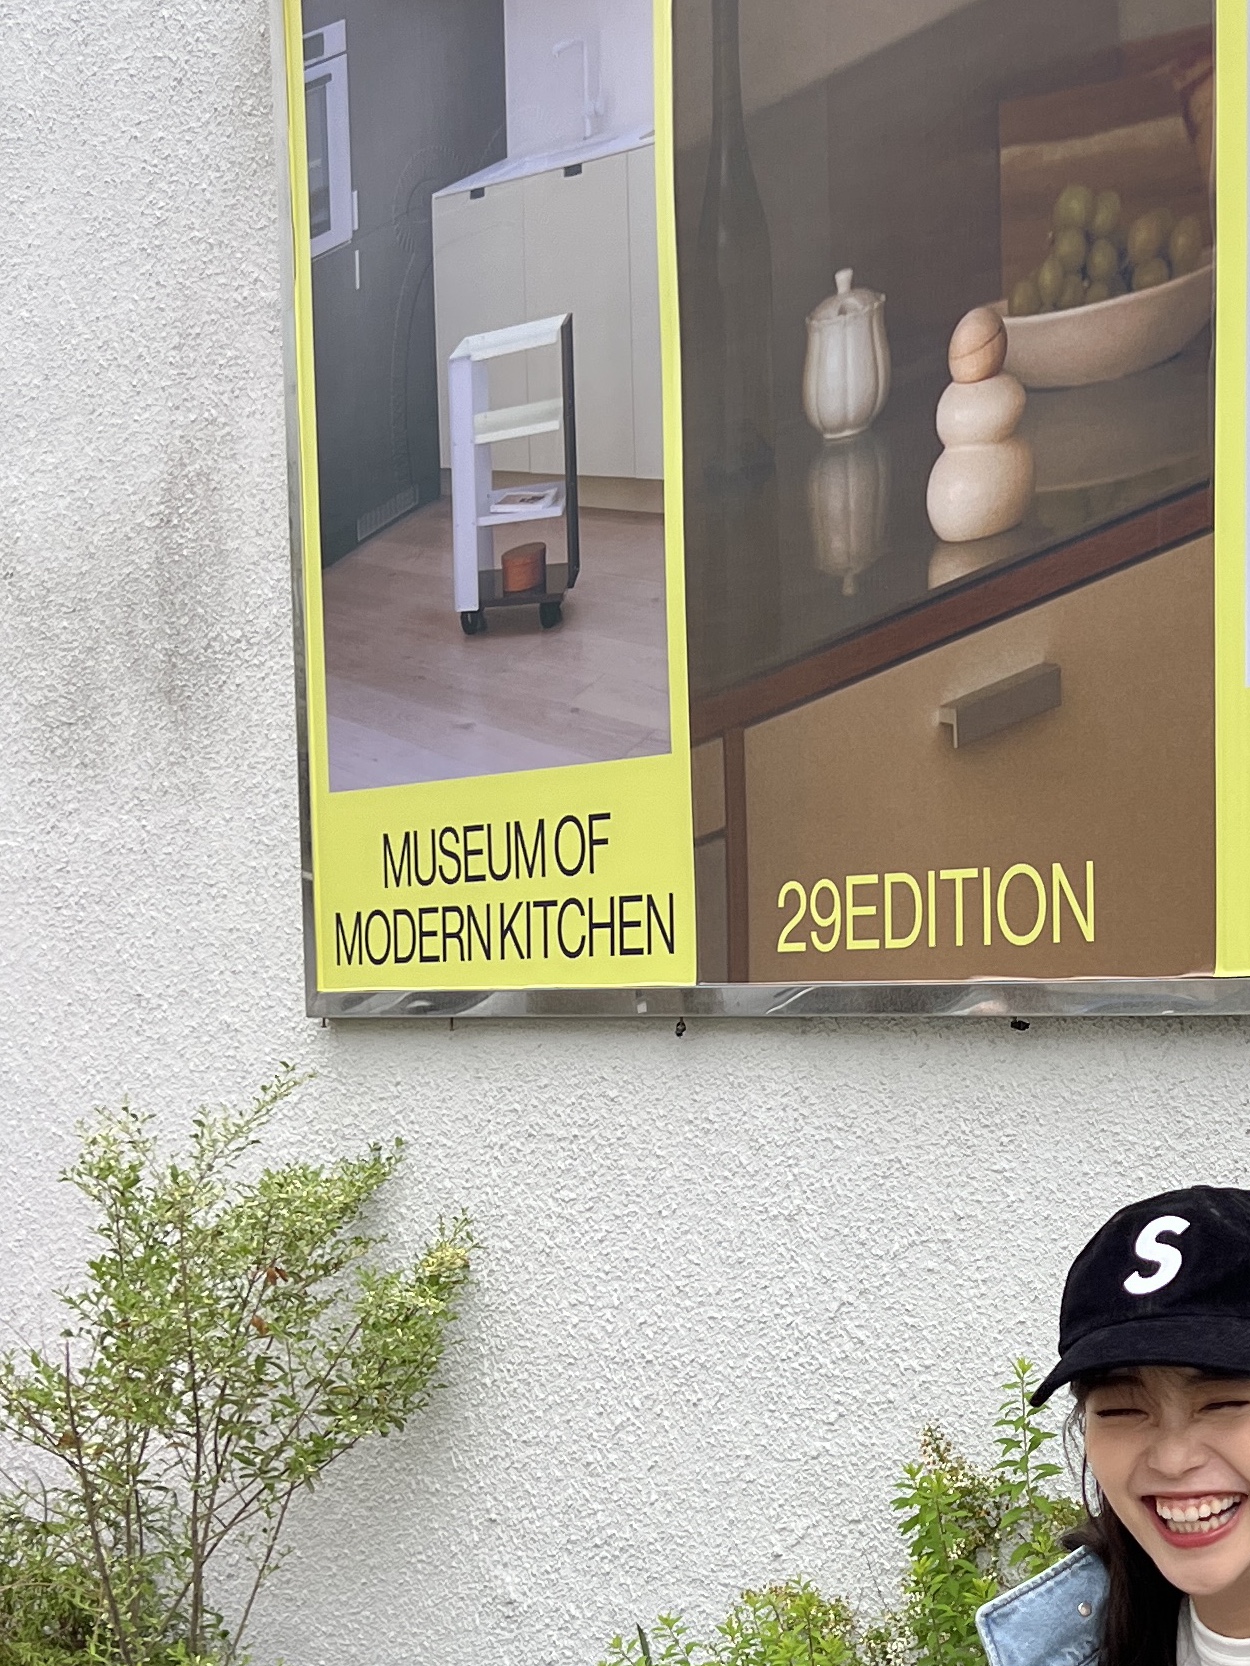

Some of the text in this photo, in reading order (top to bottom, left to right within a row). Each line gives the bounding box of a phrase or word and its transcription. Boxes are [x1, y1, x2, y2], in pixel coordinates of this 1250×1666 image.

[381, 812, 612, 889] MUSEUM OF
[334, 891, 676, 967] MODERN KITCHEN
[776, 860, 1096, 954] 29EDITION
[1122, 1214, 1191, 1296] S
